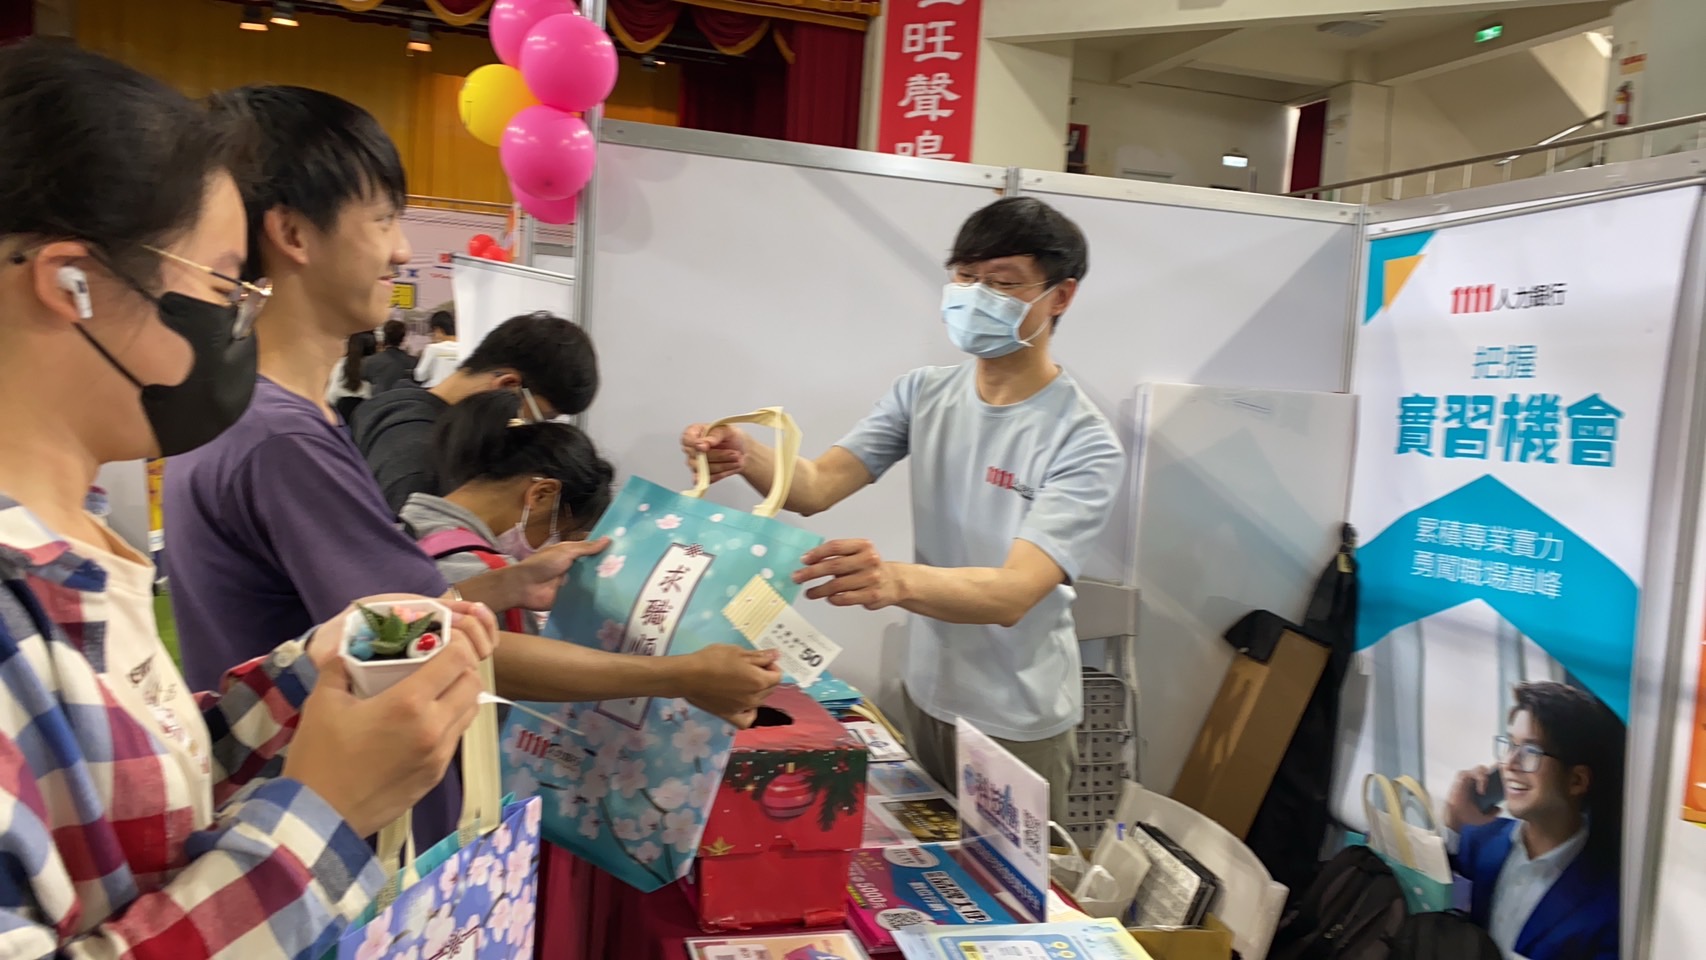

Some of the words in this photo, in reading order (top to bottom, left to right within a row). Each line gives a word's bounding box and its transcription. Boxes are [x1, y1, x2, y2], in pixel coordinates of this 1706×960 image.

[897, 0, 964, 160] 旺聲鳴
[1471, 345, 1537, 379] 把握
[1394, 393, 1625, 467] 實習機會
[621, 564, 691, 657] 求職順
[799, 648, 823, 667] 50
